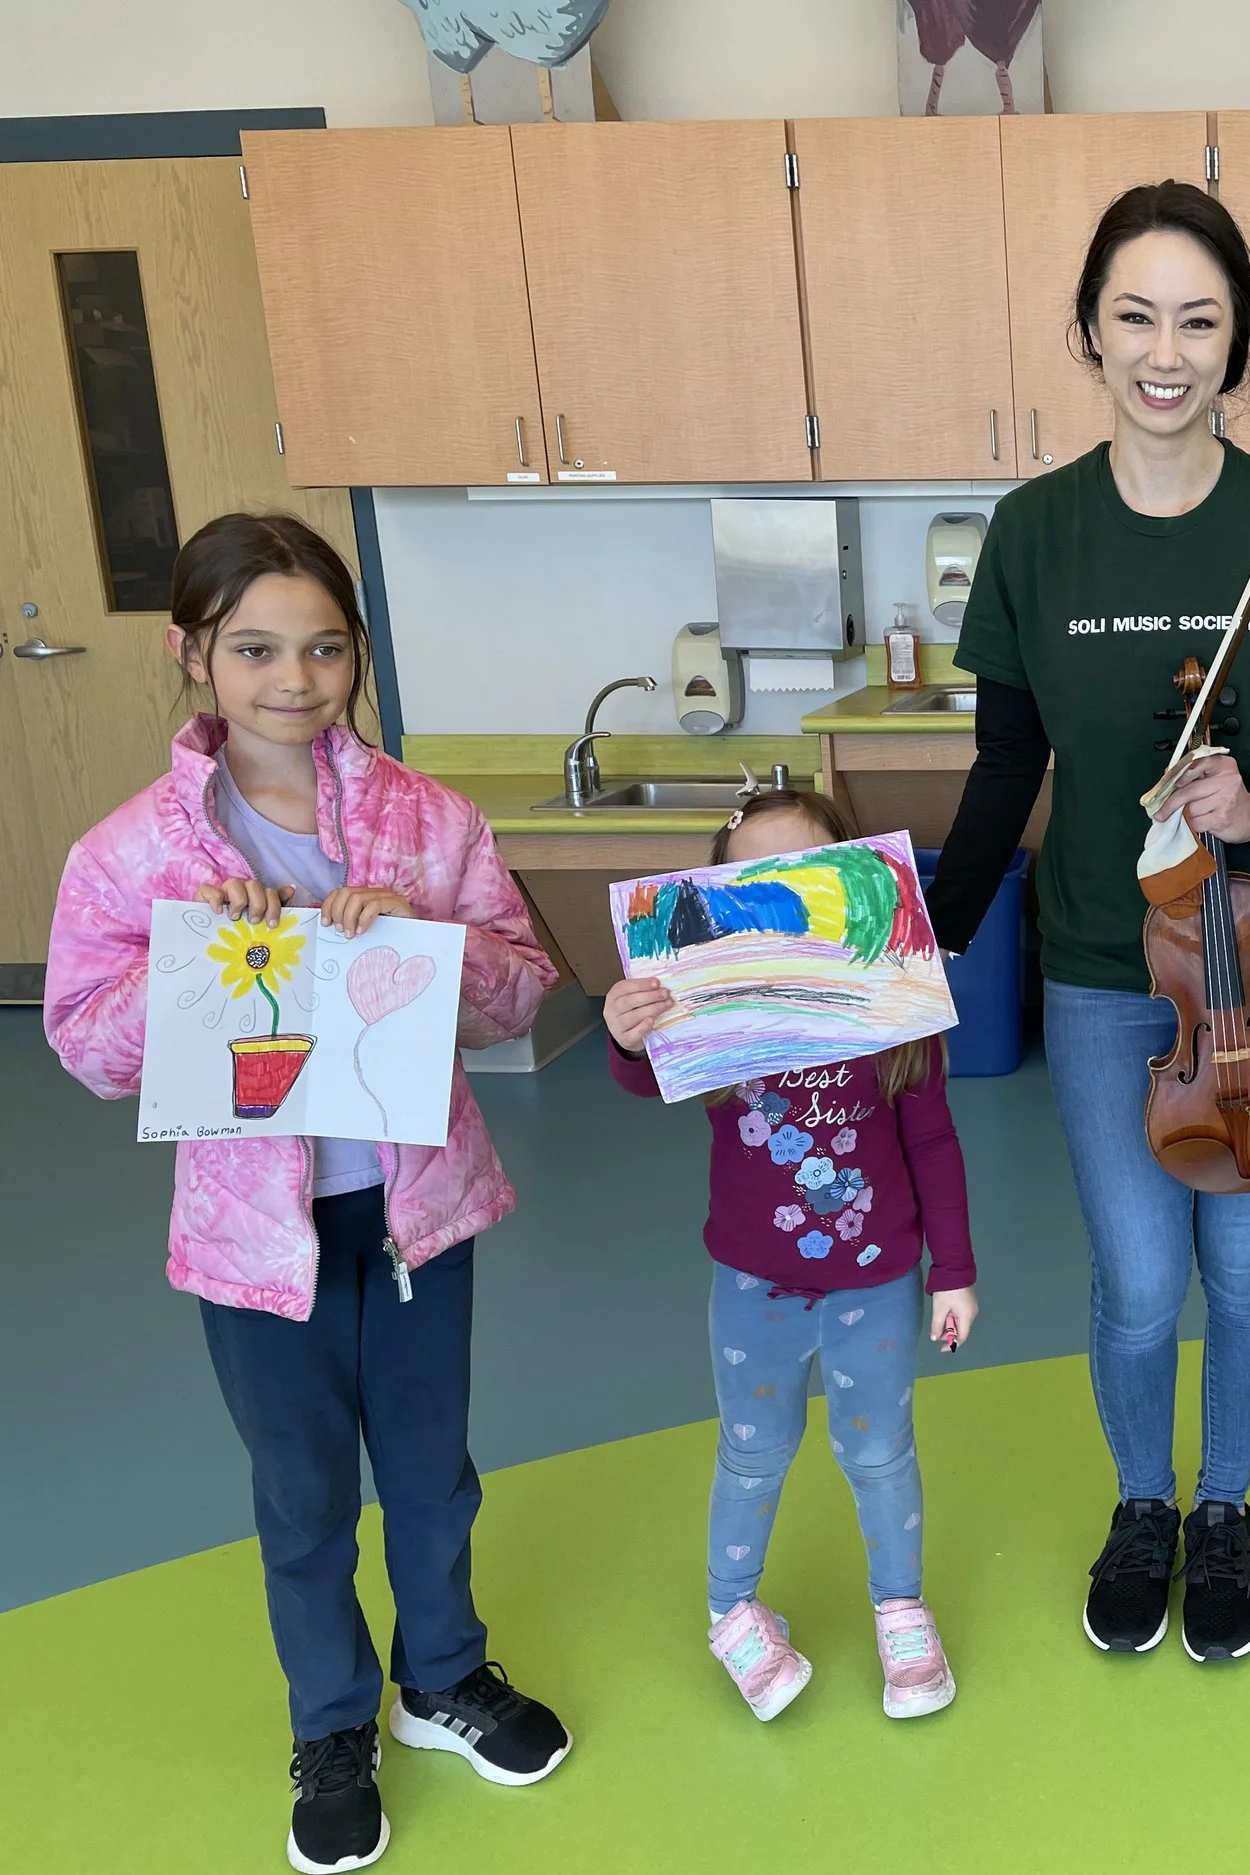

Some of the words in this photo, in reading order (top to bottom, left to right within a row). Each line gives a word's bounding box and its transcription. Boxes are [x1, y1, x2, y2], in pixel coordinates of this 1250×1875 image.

[1067, 618, 1106, 635] SOLI
[1112, 615, 1172, 632] MUSIC
[778, 1063, 854, 1089] Best
[795, 1091, 876, 1128] Sister
[142, 1125, 190, 1139] Sophia
[196, 1125, 242, 1137] Bowman
